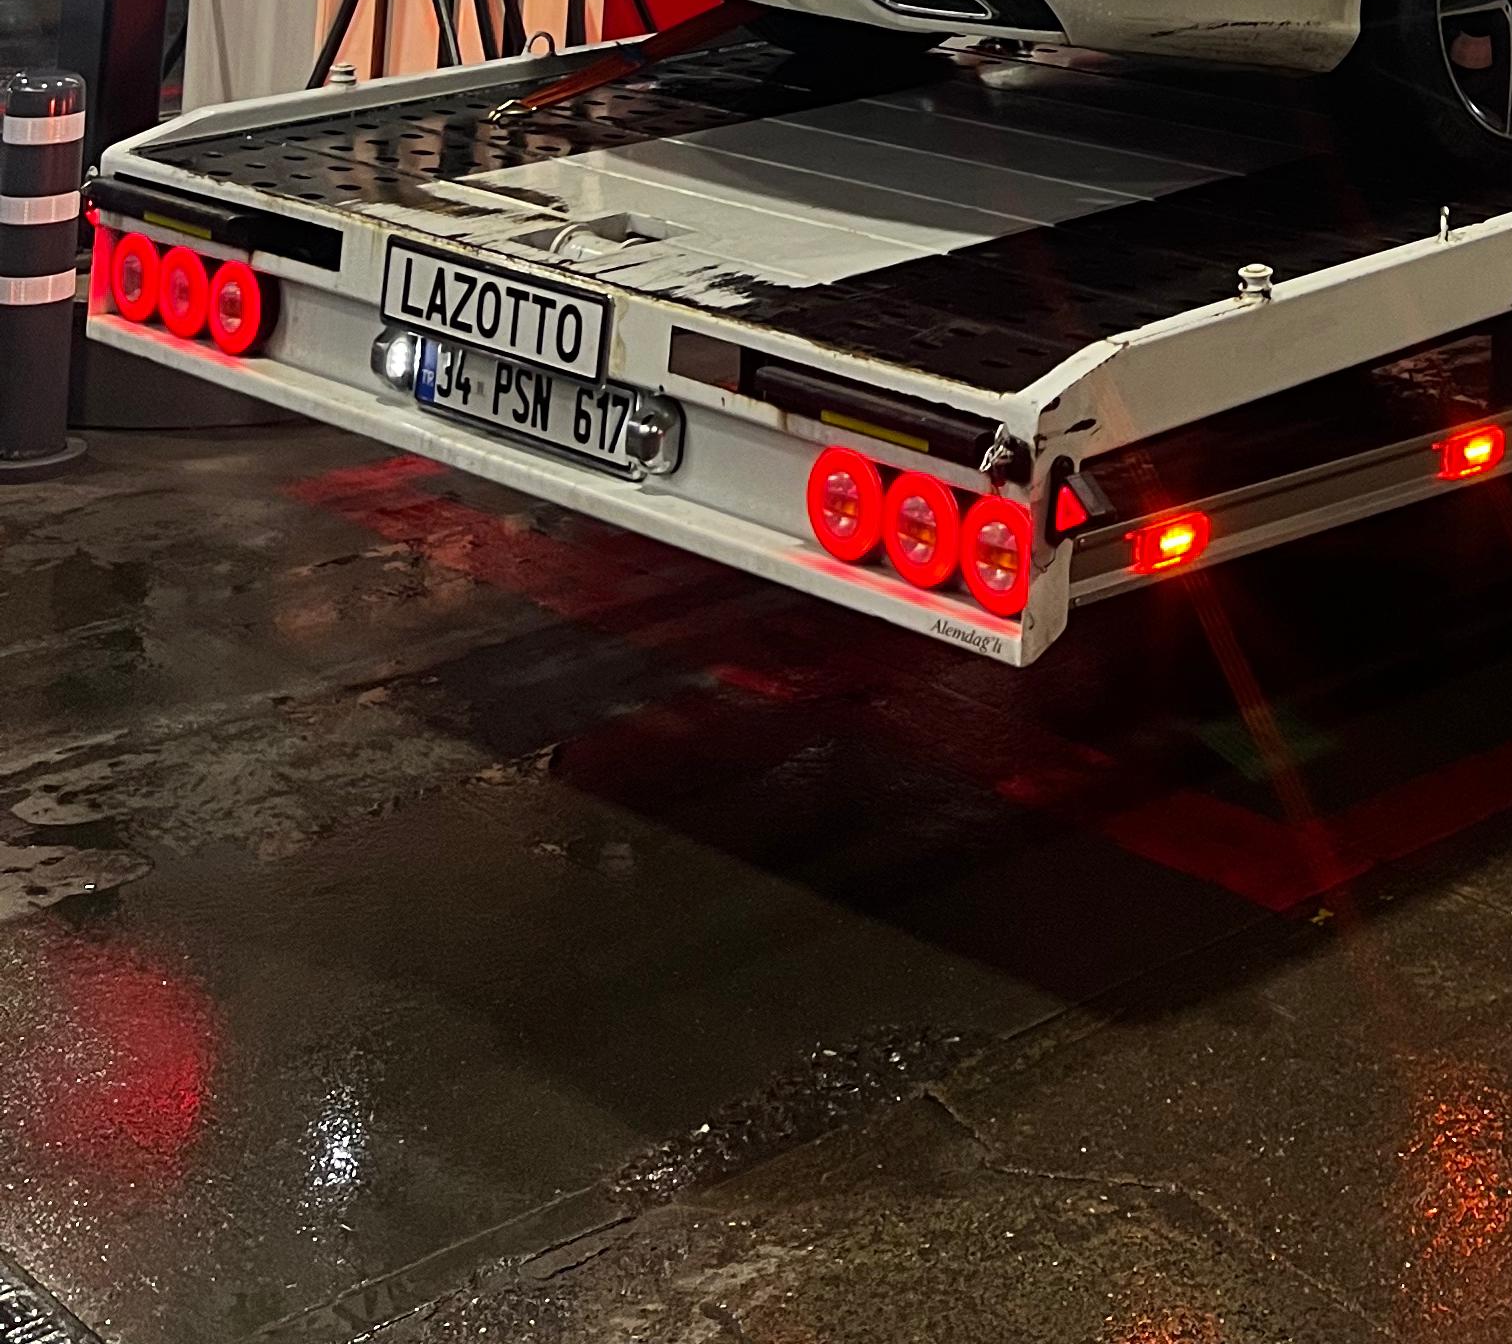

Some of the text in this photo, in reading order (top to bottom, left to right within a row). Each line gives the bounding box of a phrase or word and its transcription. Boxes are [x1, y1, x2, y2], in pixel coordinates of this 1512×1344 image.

[401, 257, 583, 364] LAZOTTO
[436, 345, 472, 405] 34
[492, 360, 553, 432] PSN
[573, 387, 630, 454] 617
